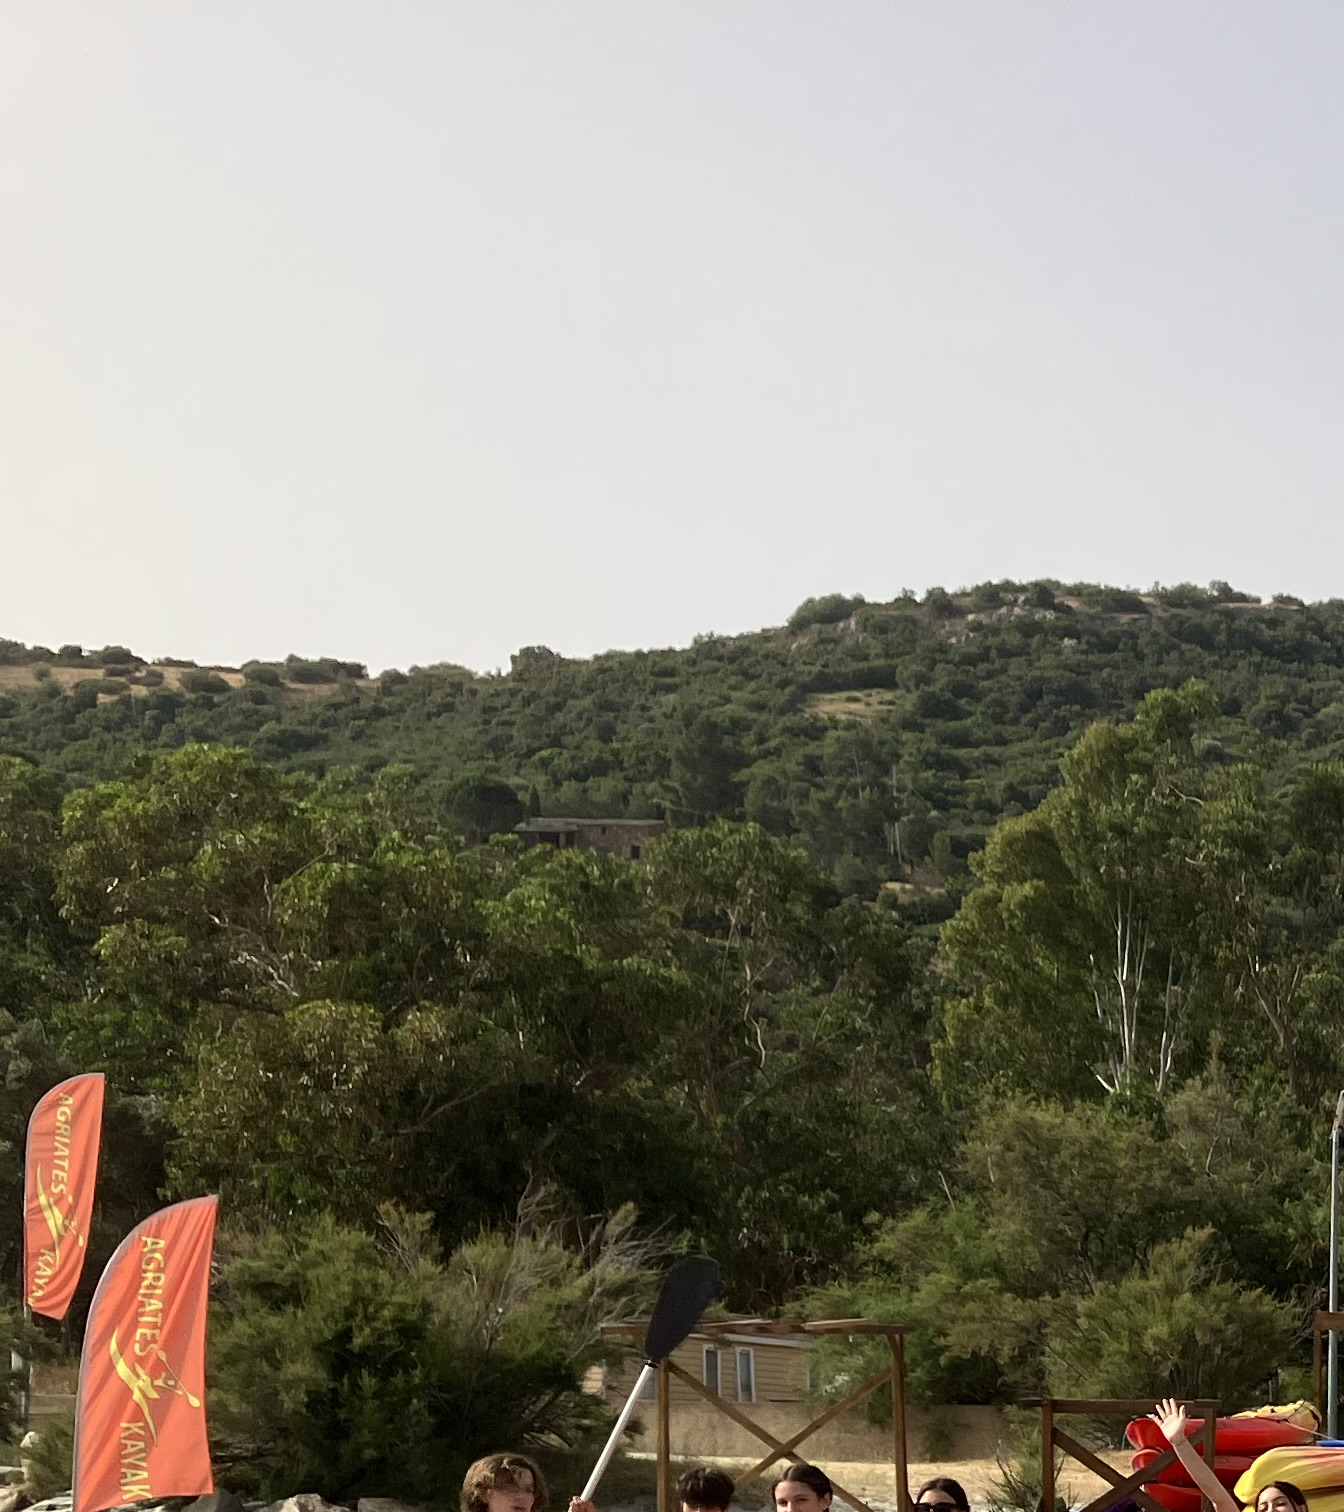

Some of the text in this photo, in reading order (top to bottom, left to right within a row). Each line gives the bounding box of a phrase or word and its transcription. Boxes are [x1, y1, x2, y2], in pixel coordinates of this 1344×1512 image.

[50, 1091, 75, 1195] AGRIATES
[133, 1236, 168, 1358] AGRIATES
[119, 1421, 153, 1501] KAYAK
